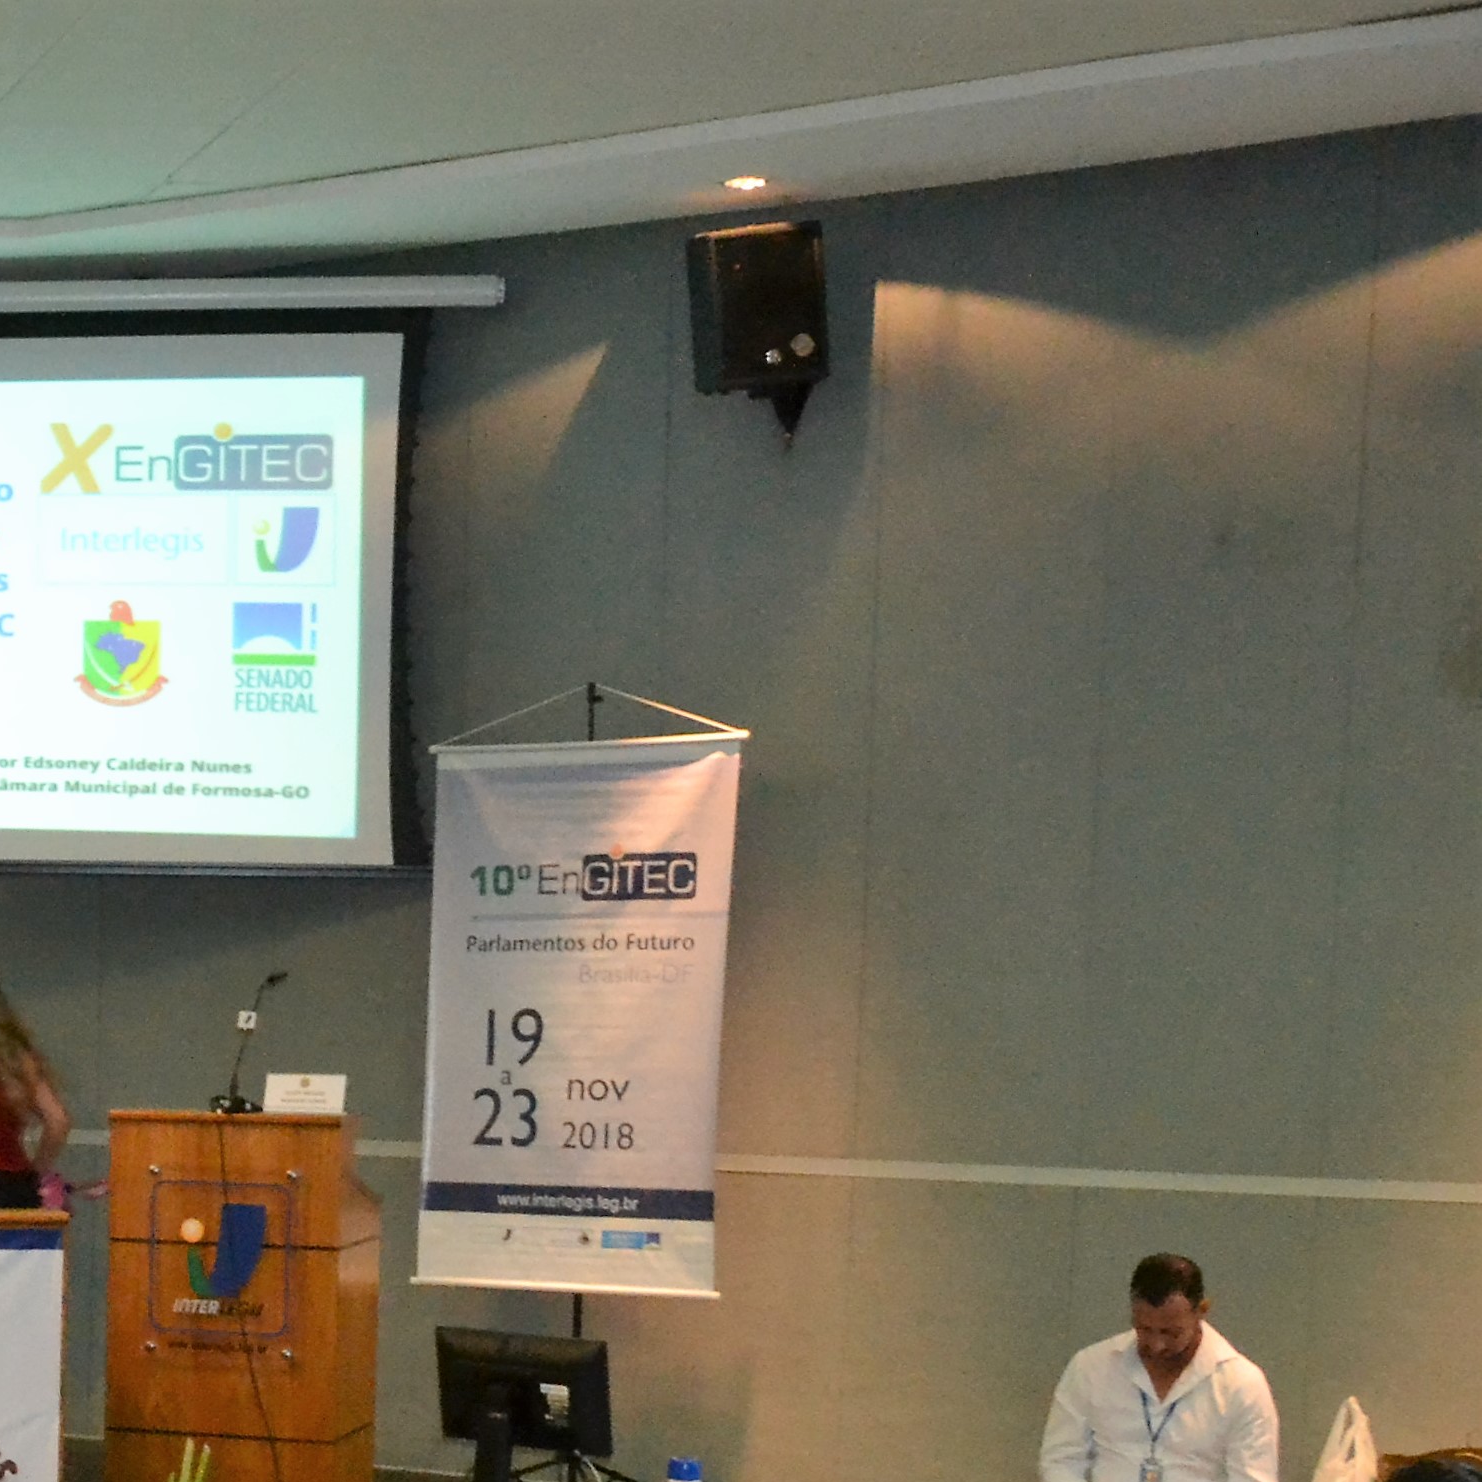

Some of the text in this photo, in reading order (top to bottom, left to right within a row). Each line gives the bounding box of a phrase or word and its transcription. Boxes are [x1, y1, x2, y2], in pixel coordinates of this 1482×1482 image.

[40, 423, 114, 493] X
[61, 528, 203, 559] Interlegis
[234, 669, 312, 689] SENADO
[234, 692, 317, 712] FEDERAL
[24, 757, 100, 773] Edsoney
[107, 758, 184, 772] Caldeira
[192, 760, 252, 774] Nunes
[65, 780, 156, 797] Municipal
[163, 782, 184, 795] de
[192, 783, 310, 799] Formosa-GO
[467, 933, 694, 952] Parlamentos do Futuro
[486, 1008, 543, 1066] 19
[501, 1070, 512, 1085] a
[567, 1079, 630, 1101] nov
[473, 1088, 537, 1146] 23
[562, 1122, 634, 1150] 2018
